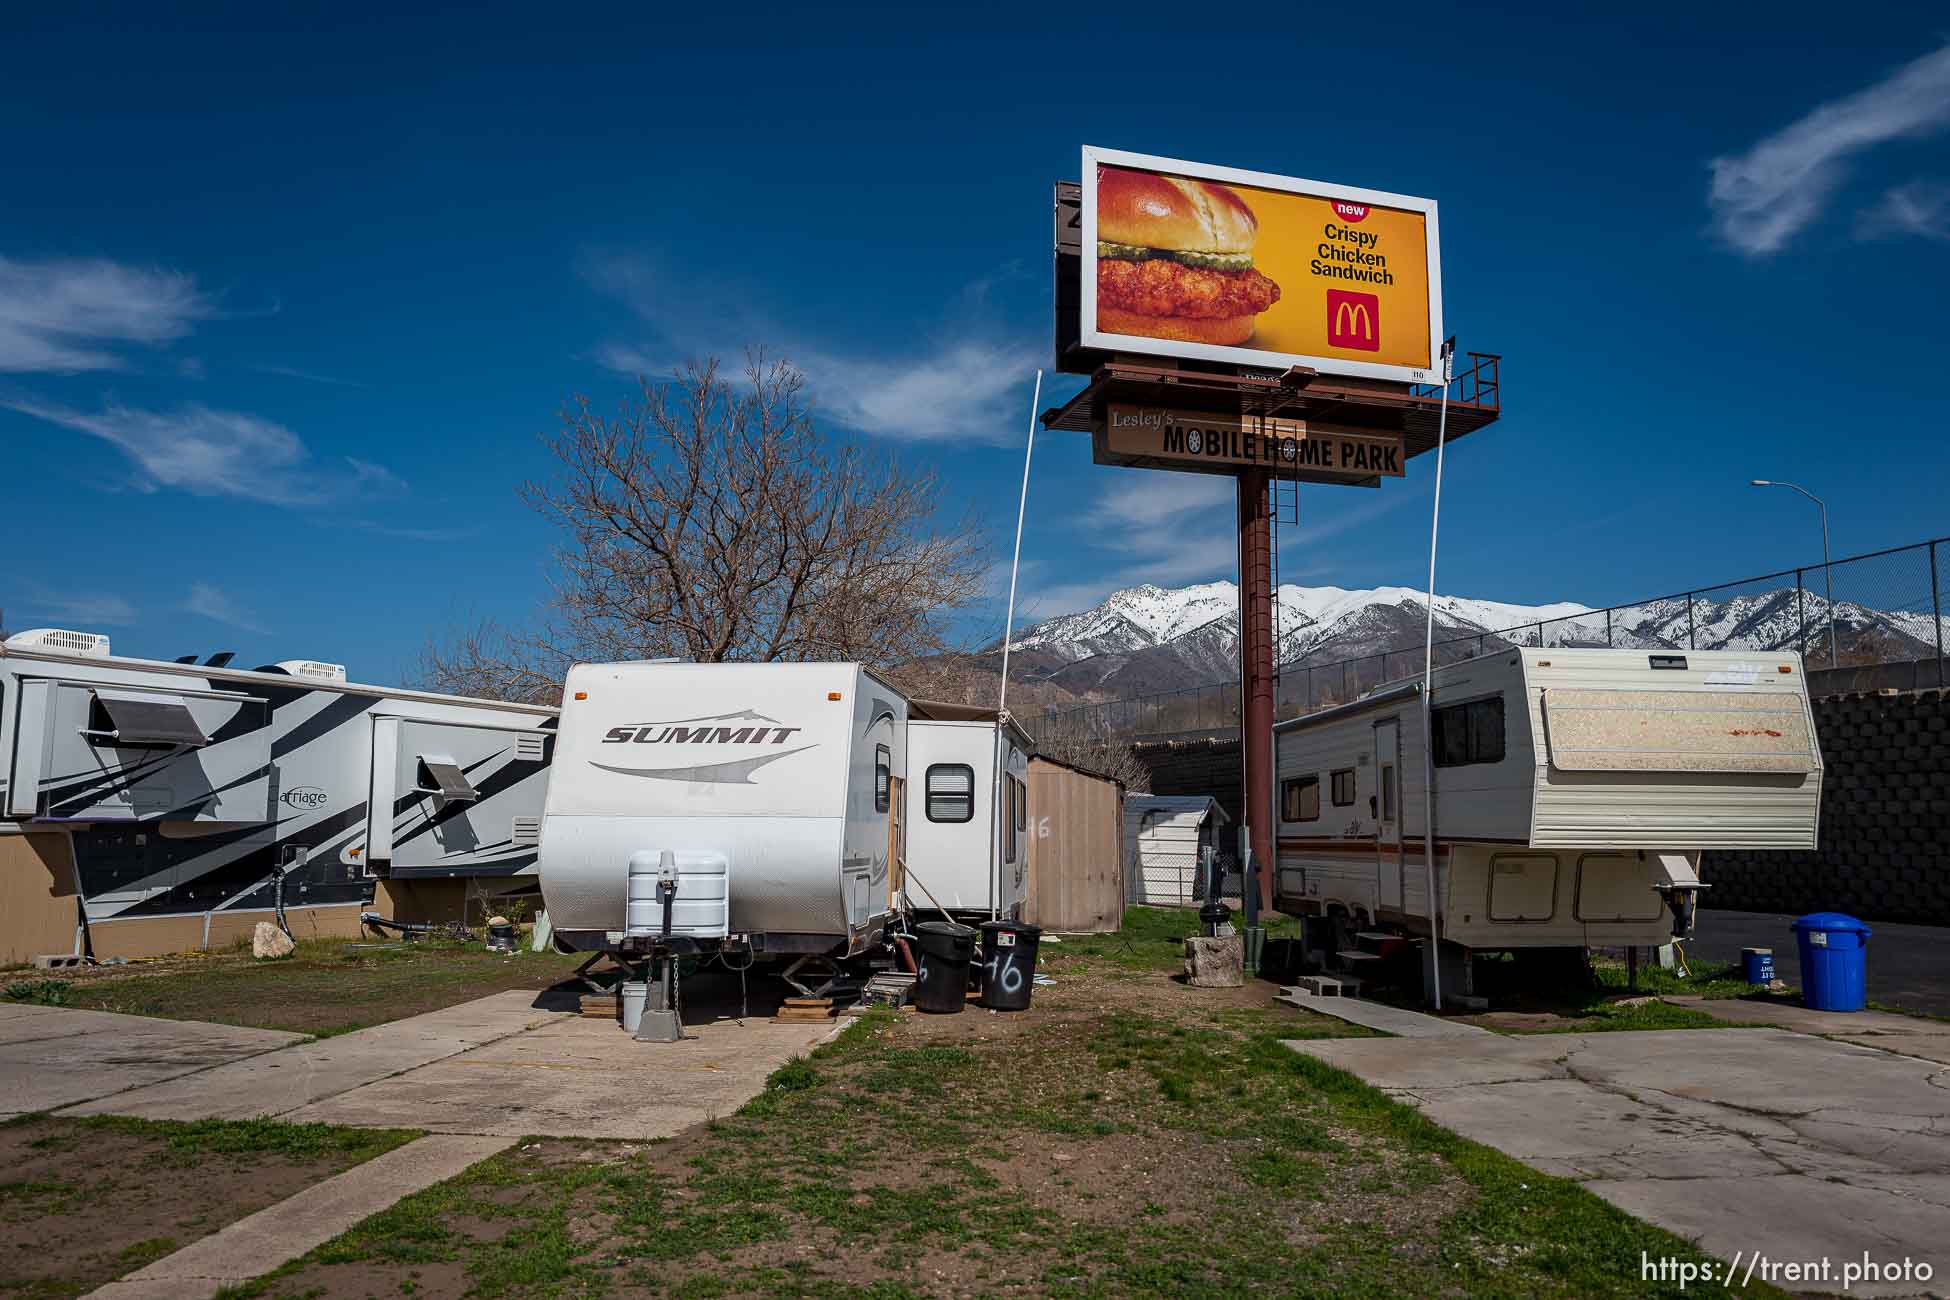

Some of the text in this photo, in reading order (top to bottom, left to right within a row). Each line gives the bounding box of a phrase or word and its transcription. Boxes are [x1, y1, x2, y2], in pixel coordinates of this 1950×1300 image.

[1337, 203, 1365, 216] new
[1324, 223, 1378, 249] Crispy
[1317, 243, 1386, 267] Chicken
[1310, 259, 1393, 285] Sandwich
[1111, 410, 1174, 431] Lesley's
[1163, 425, 1399, 472] MOBILE HOME PARK
[601, 727, 802, 744] SUMMIT
[984, 952, 1022, 993] 16
